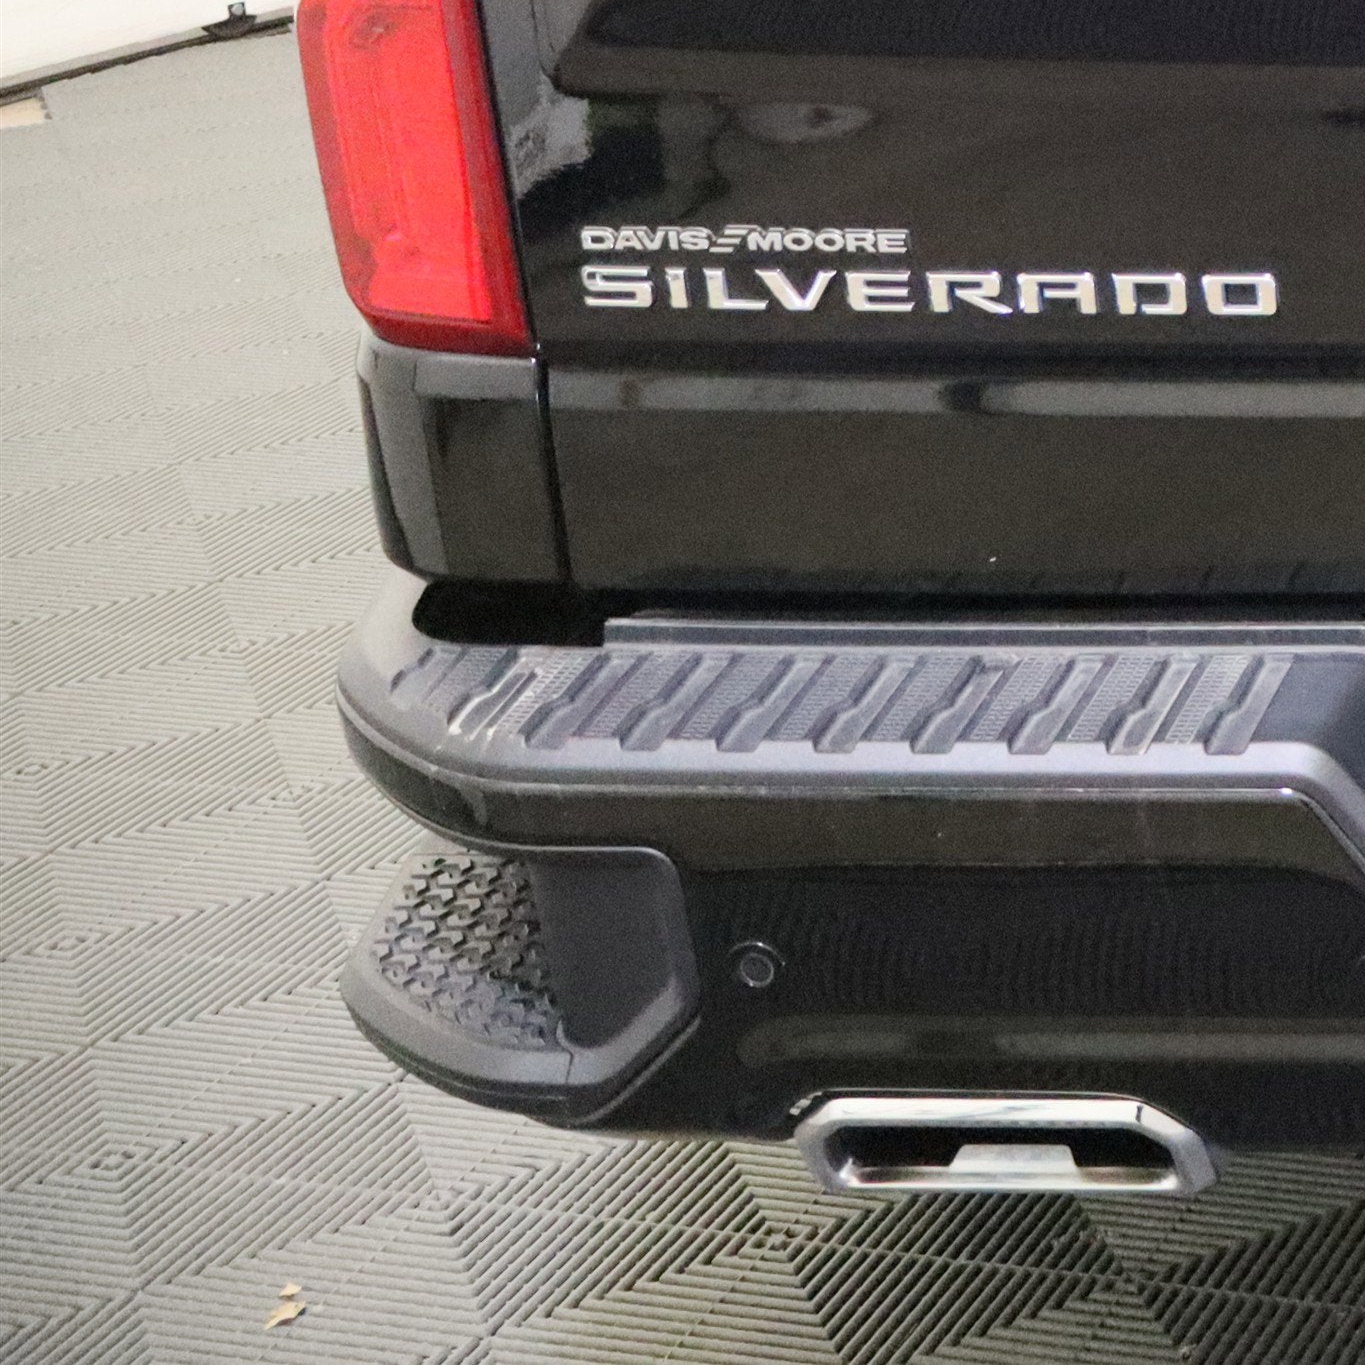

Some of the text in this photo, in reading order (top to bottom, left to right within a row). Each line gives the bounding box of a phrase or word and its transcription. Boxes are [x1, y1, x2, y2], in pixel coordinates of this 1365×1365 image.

[581, 225, 909, 254] DAVIS MOORE
[581, 264, 1278, 316] SILVERADO
